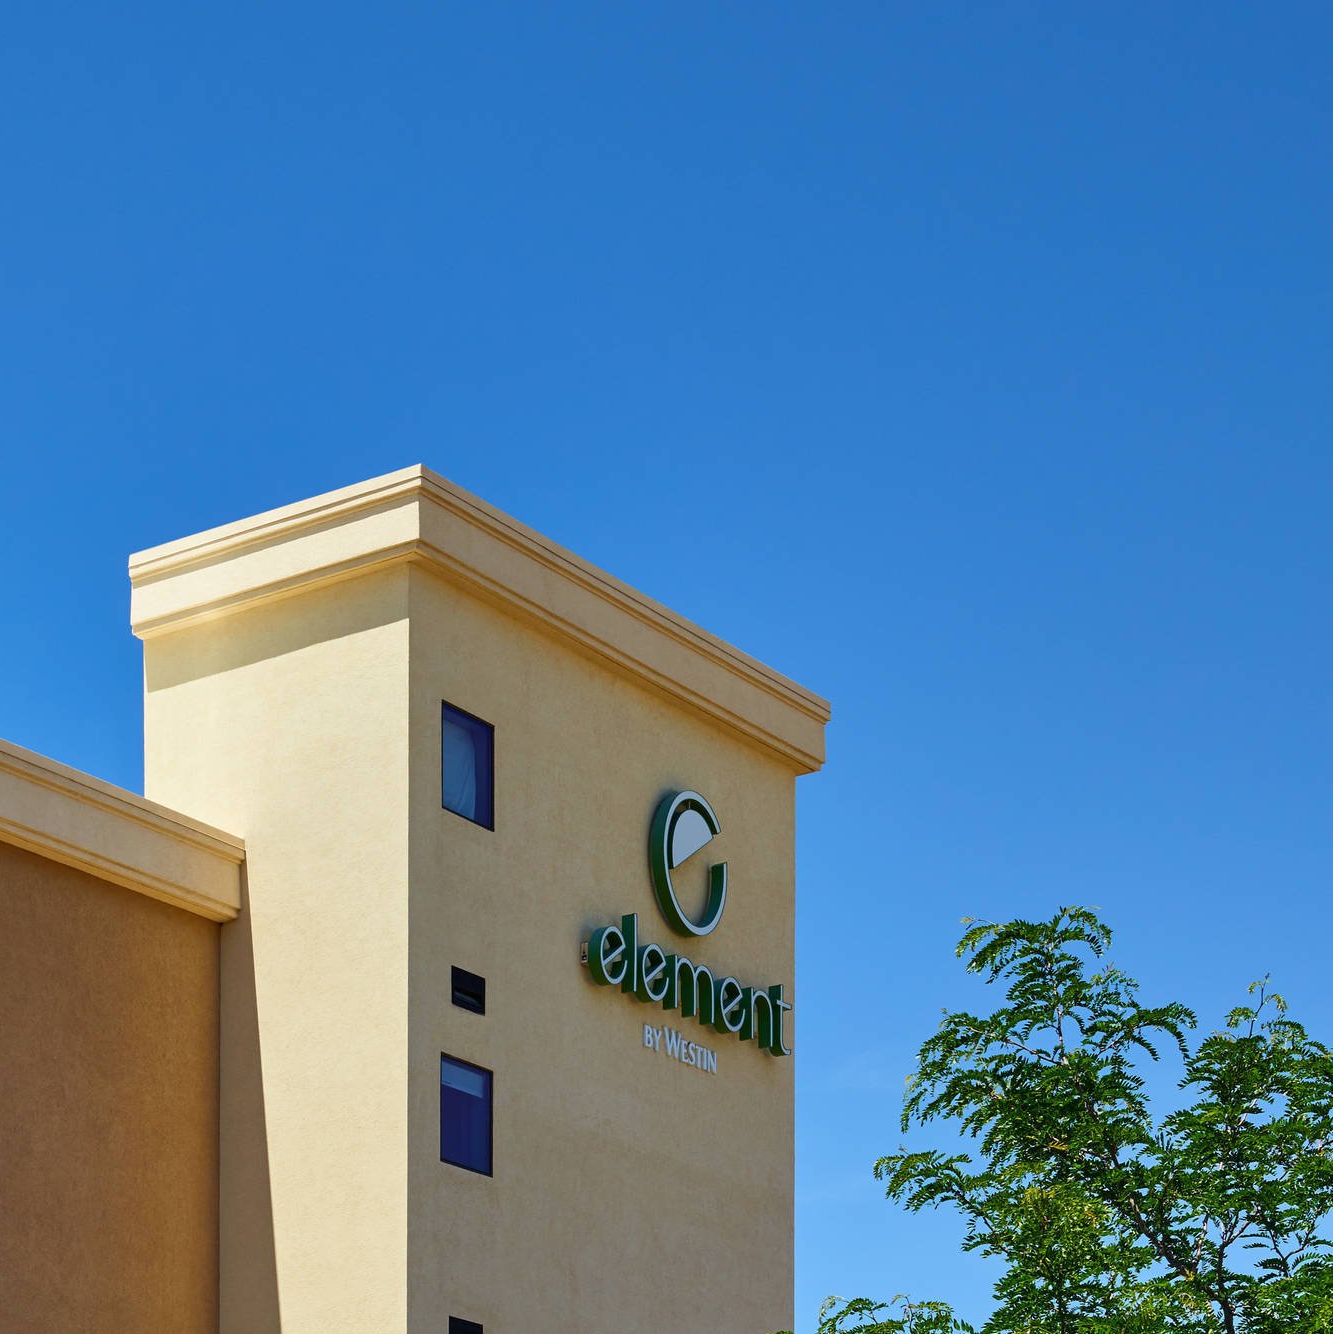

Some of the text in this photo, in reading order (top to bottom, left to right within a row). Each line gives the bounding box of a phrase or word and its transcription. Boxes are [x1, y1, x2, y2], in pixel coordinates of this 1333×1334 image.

[589, 912, 793, 1056] element
[643, 1023, 718, 1075] BY WESTIN
